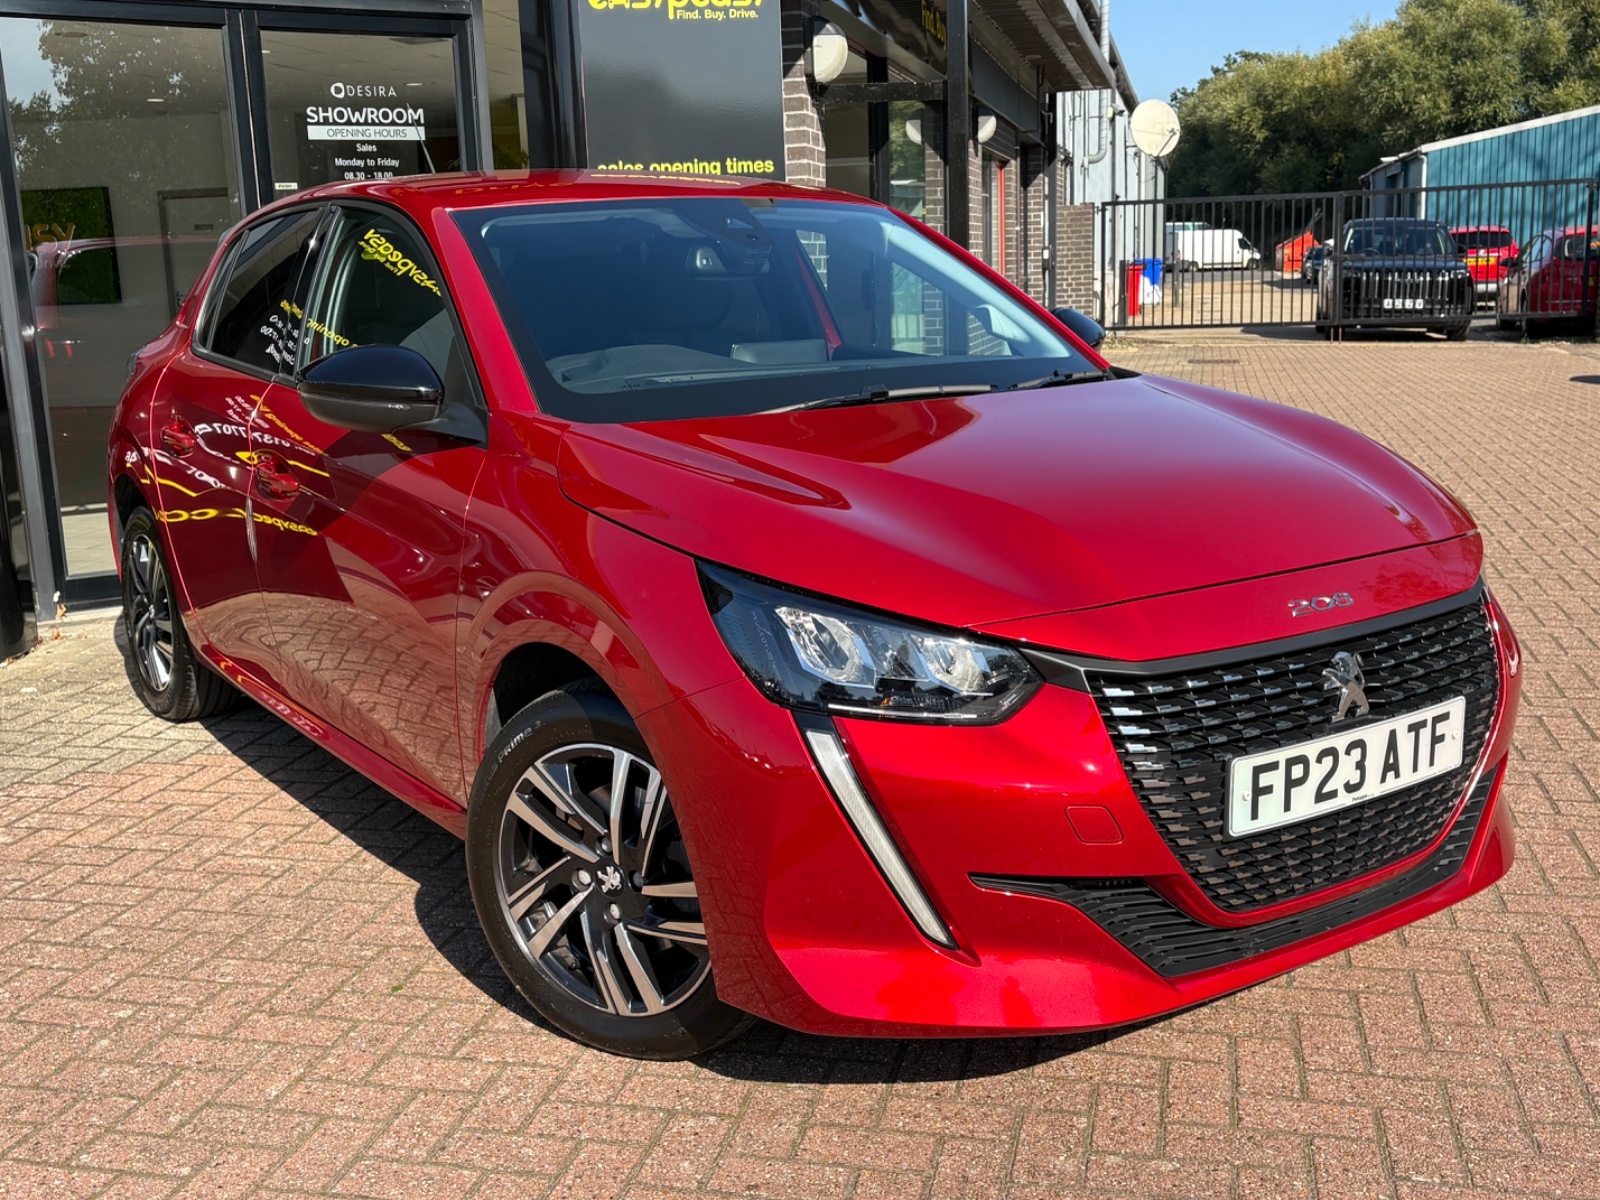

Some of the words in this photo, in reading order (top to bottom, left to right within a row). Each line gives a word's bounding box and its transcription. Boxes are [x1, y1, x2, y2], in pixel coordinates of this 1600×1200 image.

[676, 10, 701, 19] Find.
[704, 10, 726, 20] Buy.
[729, 8, 758, 18] Drive.
[346, 85, 397, 98] DESIRA
[306, 106, 424, 124] SHOWROOM
[326, 128, 371, 138] OPENING
[374, 129, 407, 138] HOURS
[356, 143, 377, 152] Sales
[335, 157, 365, 167] Monday
[367, 158, 375, 166] to
[377, 158, 400, 168] Friday
[726, 157, 774, 174] times
[1287, 591, 1354, 617] 208
[1250, 738, 1367, 821] FP23
[1380, 711, 1451, 784] ATF
